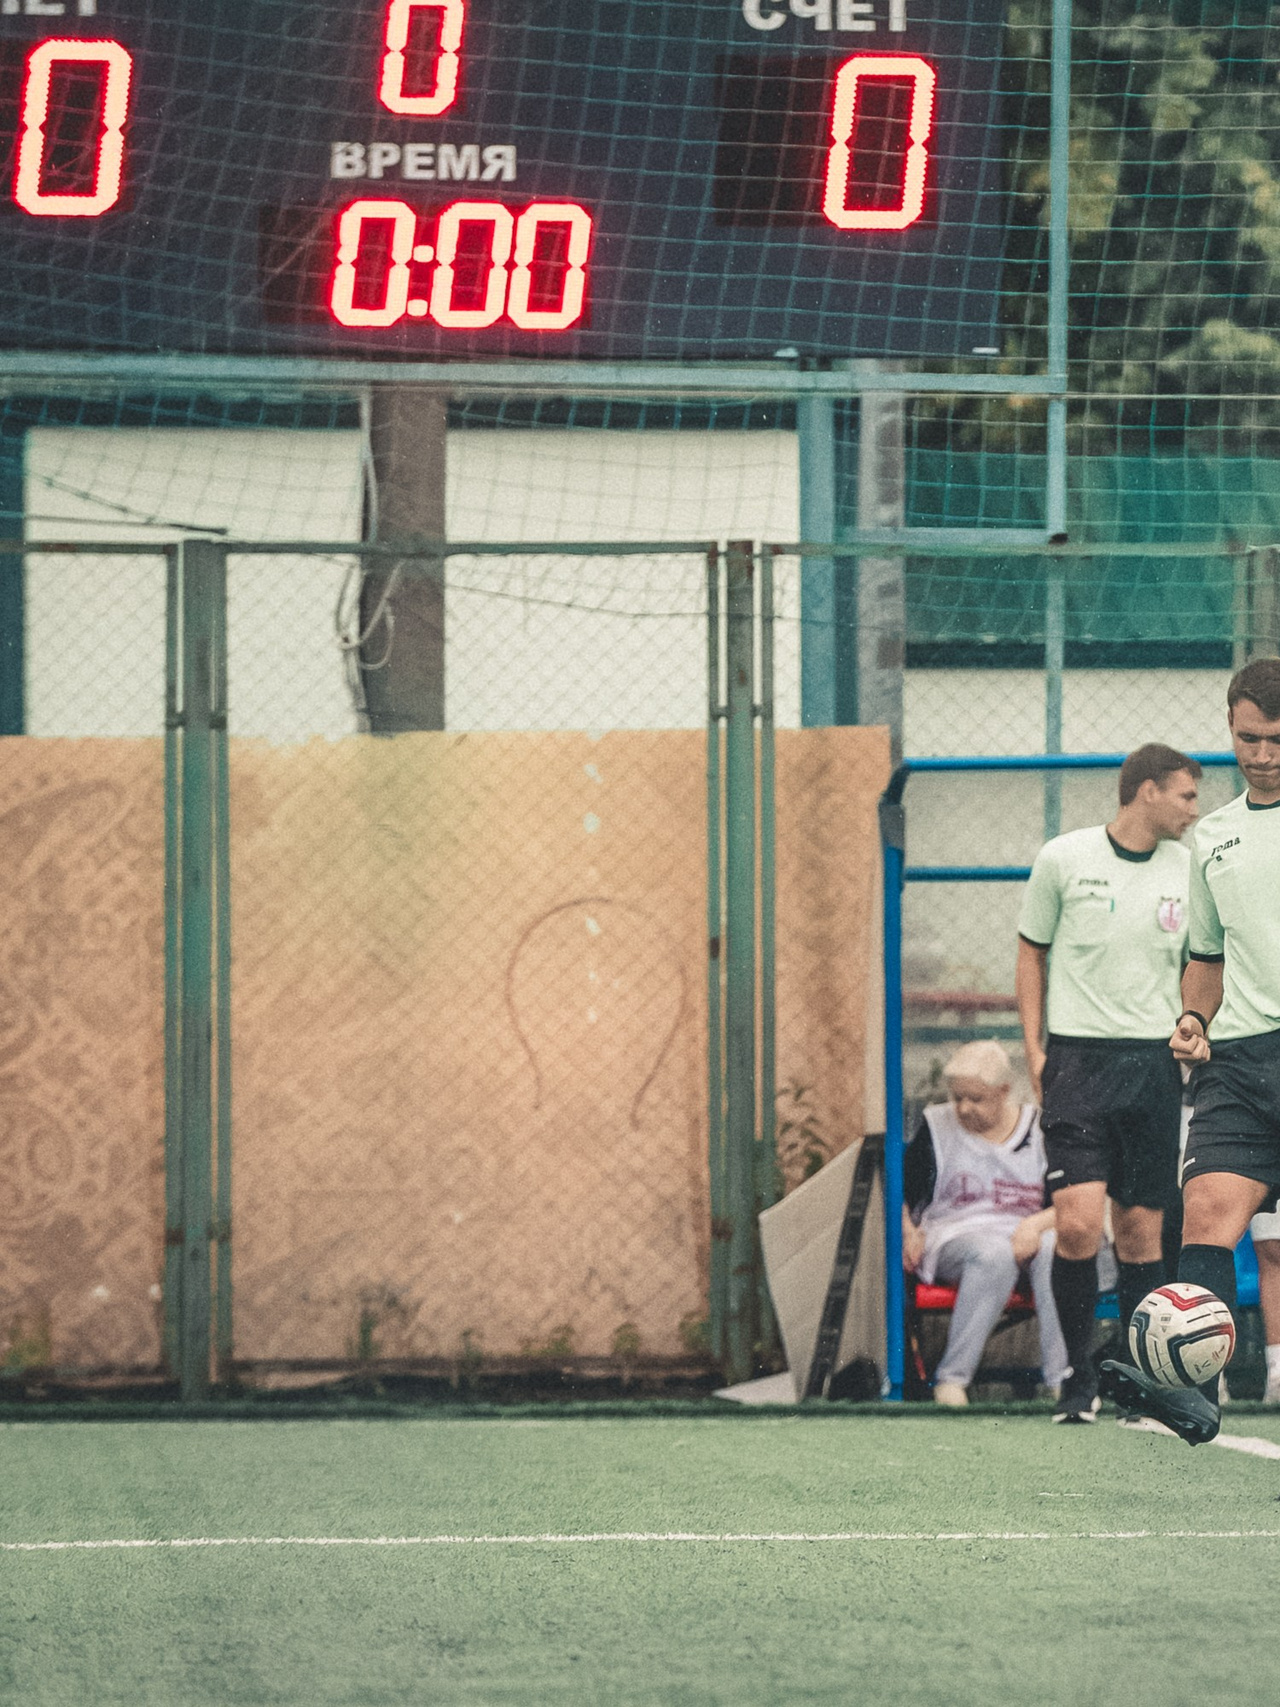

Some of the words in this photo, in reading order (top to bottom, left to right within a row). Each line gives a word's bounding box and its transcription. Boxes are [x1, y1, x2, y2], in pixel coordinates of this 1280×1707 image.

[380, 0, 465, 115] 0
[14, 38, 133, 217] 0
[330, 142, 517, 182] ВРЕМЯ
[822, 56, 936, 230] 0
[330, 200, 592, 330] 0:00
